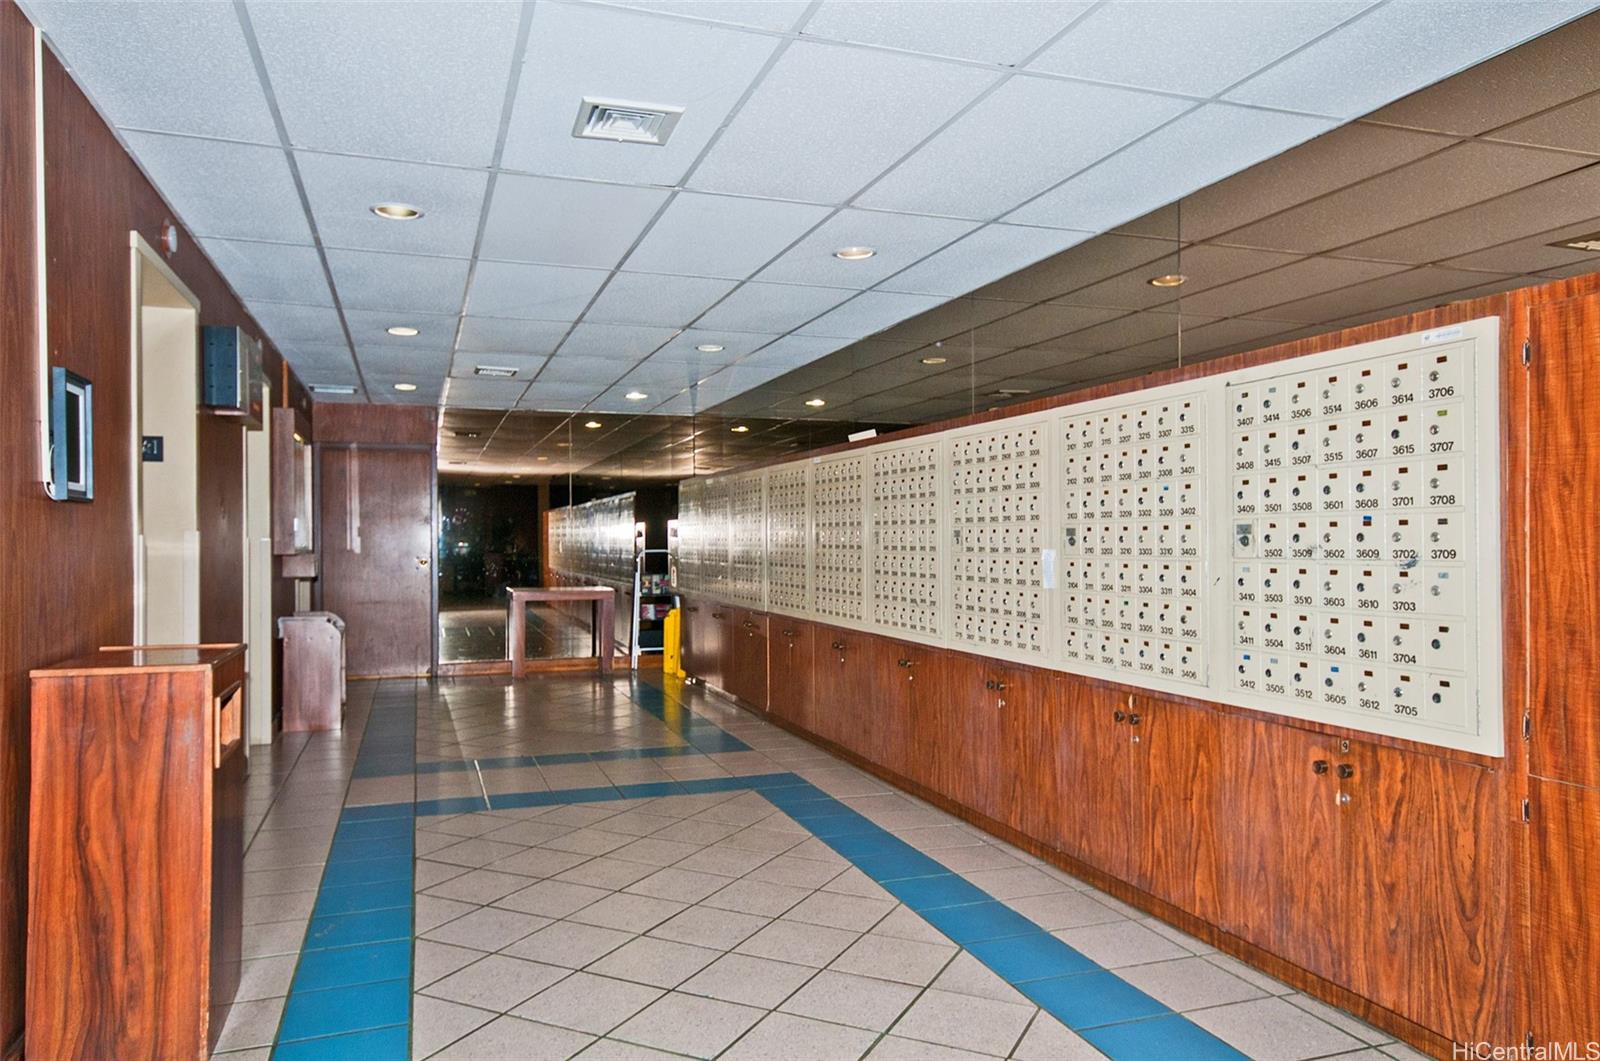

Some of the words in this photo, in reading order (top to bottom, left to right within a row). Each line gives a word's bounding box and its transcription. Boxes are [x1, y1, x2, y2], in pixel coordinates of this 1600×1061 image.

[1429, 386, 1454, 399] 3706
[1392, 393, 1413, 404] 3614
[1355, 398, 1378, 410] 3606
[1291, 408, 1311, 419] 3506
[1323, 404, 1342, 415] 3514
[1237, 417, 1254, 427] 3407
[1264, 413, 1280, 423] 3414
[1158, 429, 1172, 438] 3307
[1181, 425, 1195, 434] 3315
[1393, 444, 1415, 455] 3615
[1430, 441, 1454, 452] 3707
[1324, 452, 1343, 462] 3515
[1356, 449, 1378, 459] 3607
[1265, 458, 1281, 467] 3415
[1292, 455, 1311, 465] 3507
[1180, 466, 1194, 474] 3401
[1236, 461, 1254, 470] 3408
[1139, 471, 1151, 479] 3301
[1158, 469, 1173, 477] 3308
[1356, 499, 1378, 509] 3608
[1393, 497, 1413, 506] 3701
[1430, 495, 1455, 505] 3708
[1237, 505, 1255, 513] 3409
[1265, 504, 1281, 512] 3501
[1292, 502, 1312, 511] 3508
[1324, 501, 1343, 510] 3601
[1139, 509, 1151, 517] 3302
[1181, 507, 1196, 515] 3402
[1181, 548, 1196, 556] 3403
[1265, 549, 1282, 557] 3502
[1324, 549, 1345, 558] 3602
[1356, 549, 1379, 558] 3609
[1392, 550, 1416, 559] 3702
[1431, 549, 1456, 559] 3709
[1161, 587, 1172, 595] 3311
[1181, 588, 1196, 596] 3404
[1239, 593, 1255, 601] 3410
[1264, 594, 1283, 603] 3503
[1294, 595, 1312, 605] 3510
[1324, 597, 1345, 607] 3603
[1358, 599, 1379, 609] 3610
[1393, 601, 1416, 611] 3703
[1139, 624, 1153, 632] 3305
[1161, 626, 1173, 635] 3312
[1182, 629, 1197, 637] 3405
[1240, 635, 1254, 644] 3411
[1265, 639, 1283, 647] 3504
[1295, 642, 1311, 651] 3511
[1324, 645, 1346, 655] 3604
[1359, 649, 1377, 659] 3611
[1393, 653, 1416, 664] 3704
[1140, 663, 1153, 671] 3306
[1161, 666, 1173, 675] 3314
[1182, 670, 1197, 679] 3406
[1240, 679, 1255, 689] 3412
[1266, 683, 1285, 694] 3505
[1295, 688, 1312, 699] 3512
[1325, 693, 1346, 705] 3605
[1360, 698, 1380, 710] 3612
[1394, 704, 1418, 716] 3705
